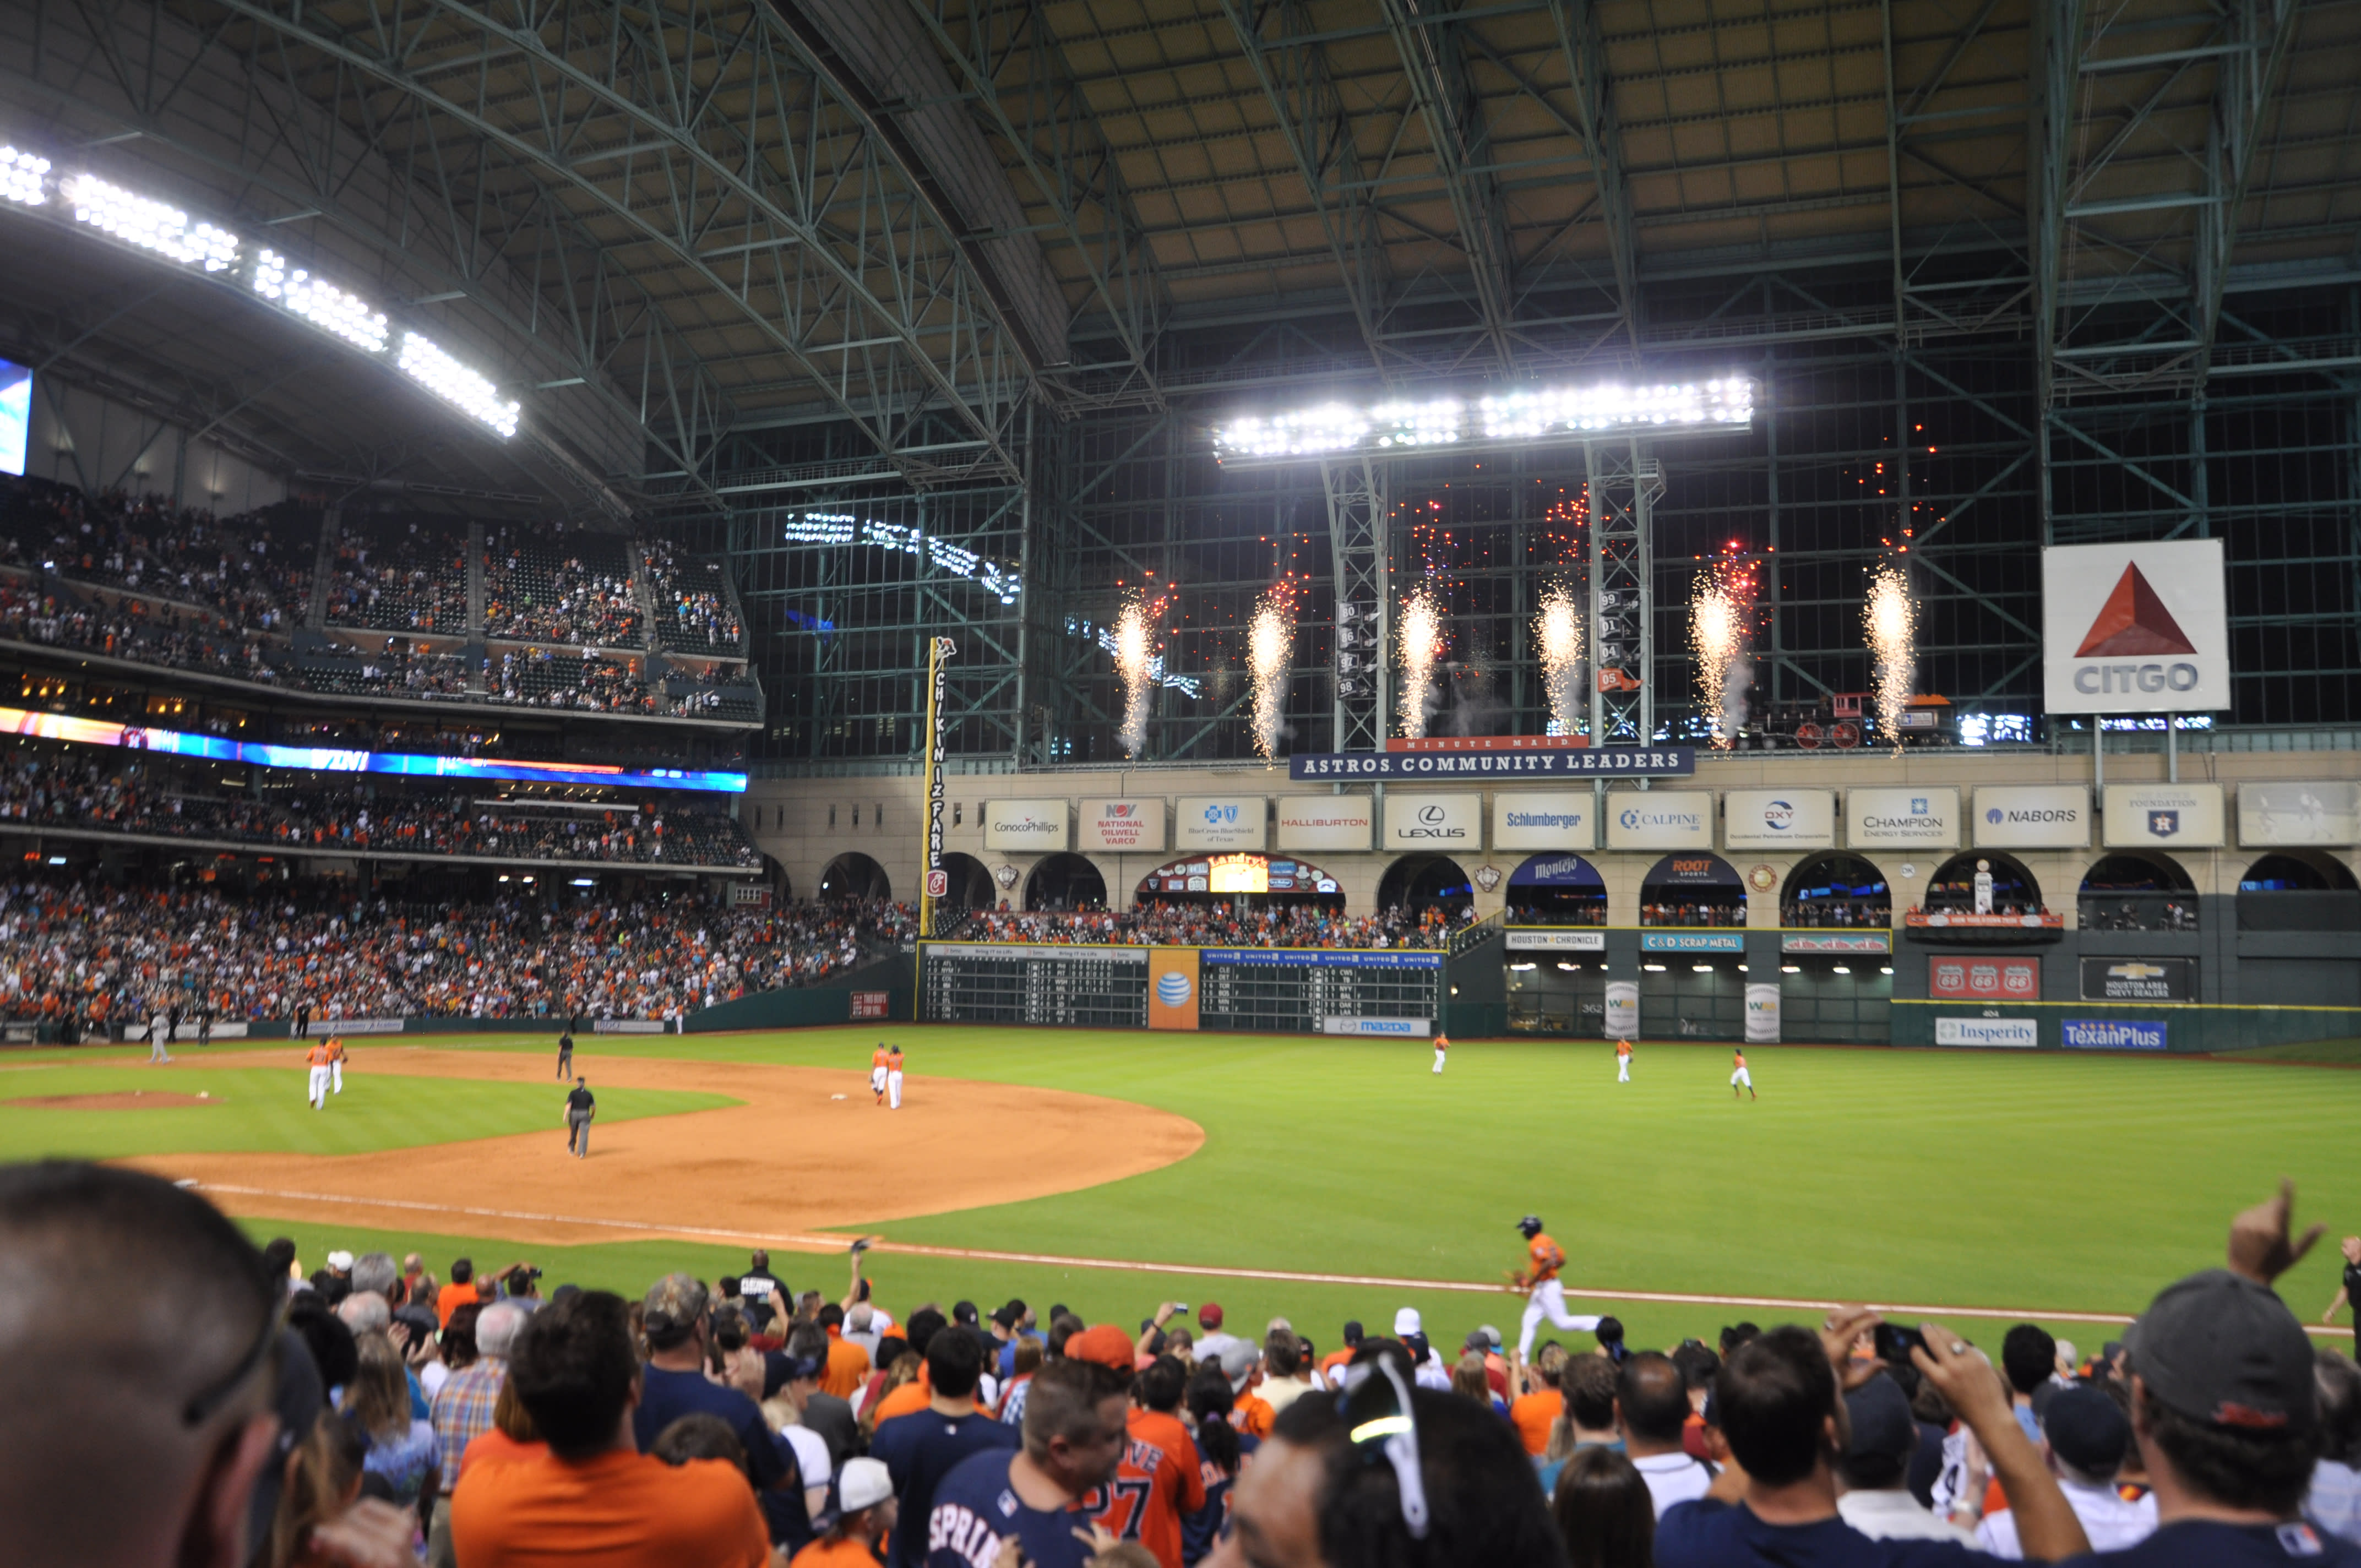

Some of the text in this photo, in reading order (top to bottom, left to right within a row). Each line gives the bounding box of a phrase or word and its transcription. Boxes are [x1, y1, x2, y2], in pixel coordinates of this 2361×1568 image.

[2074, 662, 2199, 694] CITGO
[933, 672, 945, 762] CHIKIN
[1407, 739, 1568, 749] MINUTE MAID
[311, 749, 370, 771] WIN!
[1303, 752, 1679, 774] ASTROS COMMUNITY LEADERS
[1507, 812, 1581, 829] Schlumberger
[1642, 814, 1700, 825] CALPINE
[1764, 811, 1794, 819] OXY
[2008, 810, 2076, 823] NABORS
[994, 821, 1059, 834] ConocoPhillips
[1398, 828, 1465, 838] LEXUS
[929, 801, 943, 868] FARE
[1207, 852, 1269, 869] Landry's
[1673, 860, 1713, 872] ROOT
[1511, 936, 1599, 945] HOUSTON CHRONICLE
[1648, 938, 1737, 948] C & D SCRAP METAL
[900, 944, 916, 954] 315
[1941, 976, 2027, 987] 66 66 66
[2106, 981, 2169, 990] HOUSTON AREA
[2134, 989, 2169, 998] DEALERS
[1582, 1004, 1603, 1014] 362
[1608, 999, 1636, 1009] WM
[1748, 1001, 1777, 1010] WM
[1982, 1009, 1999, 1017] 404
[1361, 1021, 1411, 1032] mazda
[1960, 1023, 2032, 1043] Insperity
[2065, 1025, 2161, 1046] TexanPlus
